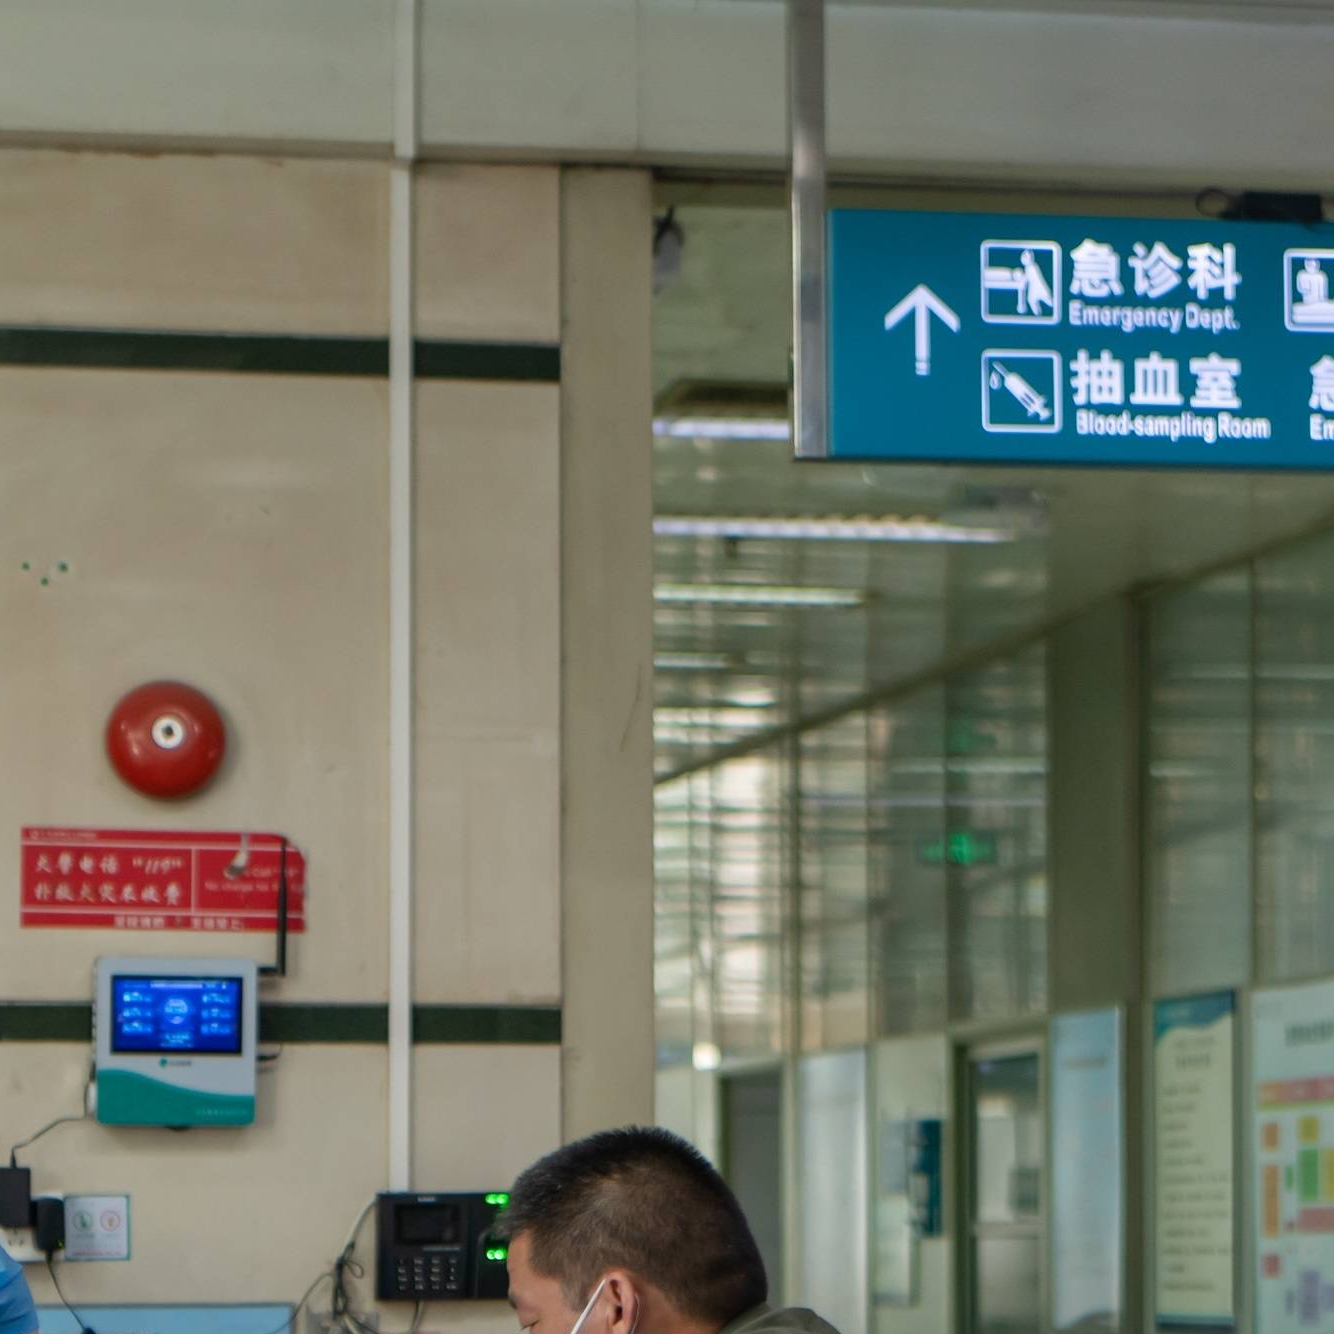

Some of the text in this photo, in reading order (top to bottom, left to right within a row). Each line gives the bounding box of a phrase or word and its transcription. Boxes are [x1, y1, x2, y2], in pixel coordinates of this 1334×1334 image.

[1069, 239, 1242, 300] 急诊科
[1069, 302, 1241, 333] Emergency Dept.
[1070, 350, 1242, 410] 抽血室
[1076, 411, 1271, 443] Blood-sampling Room
